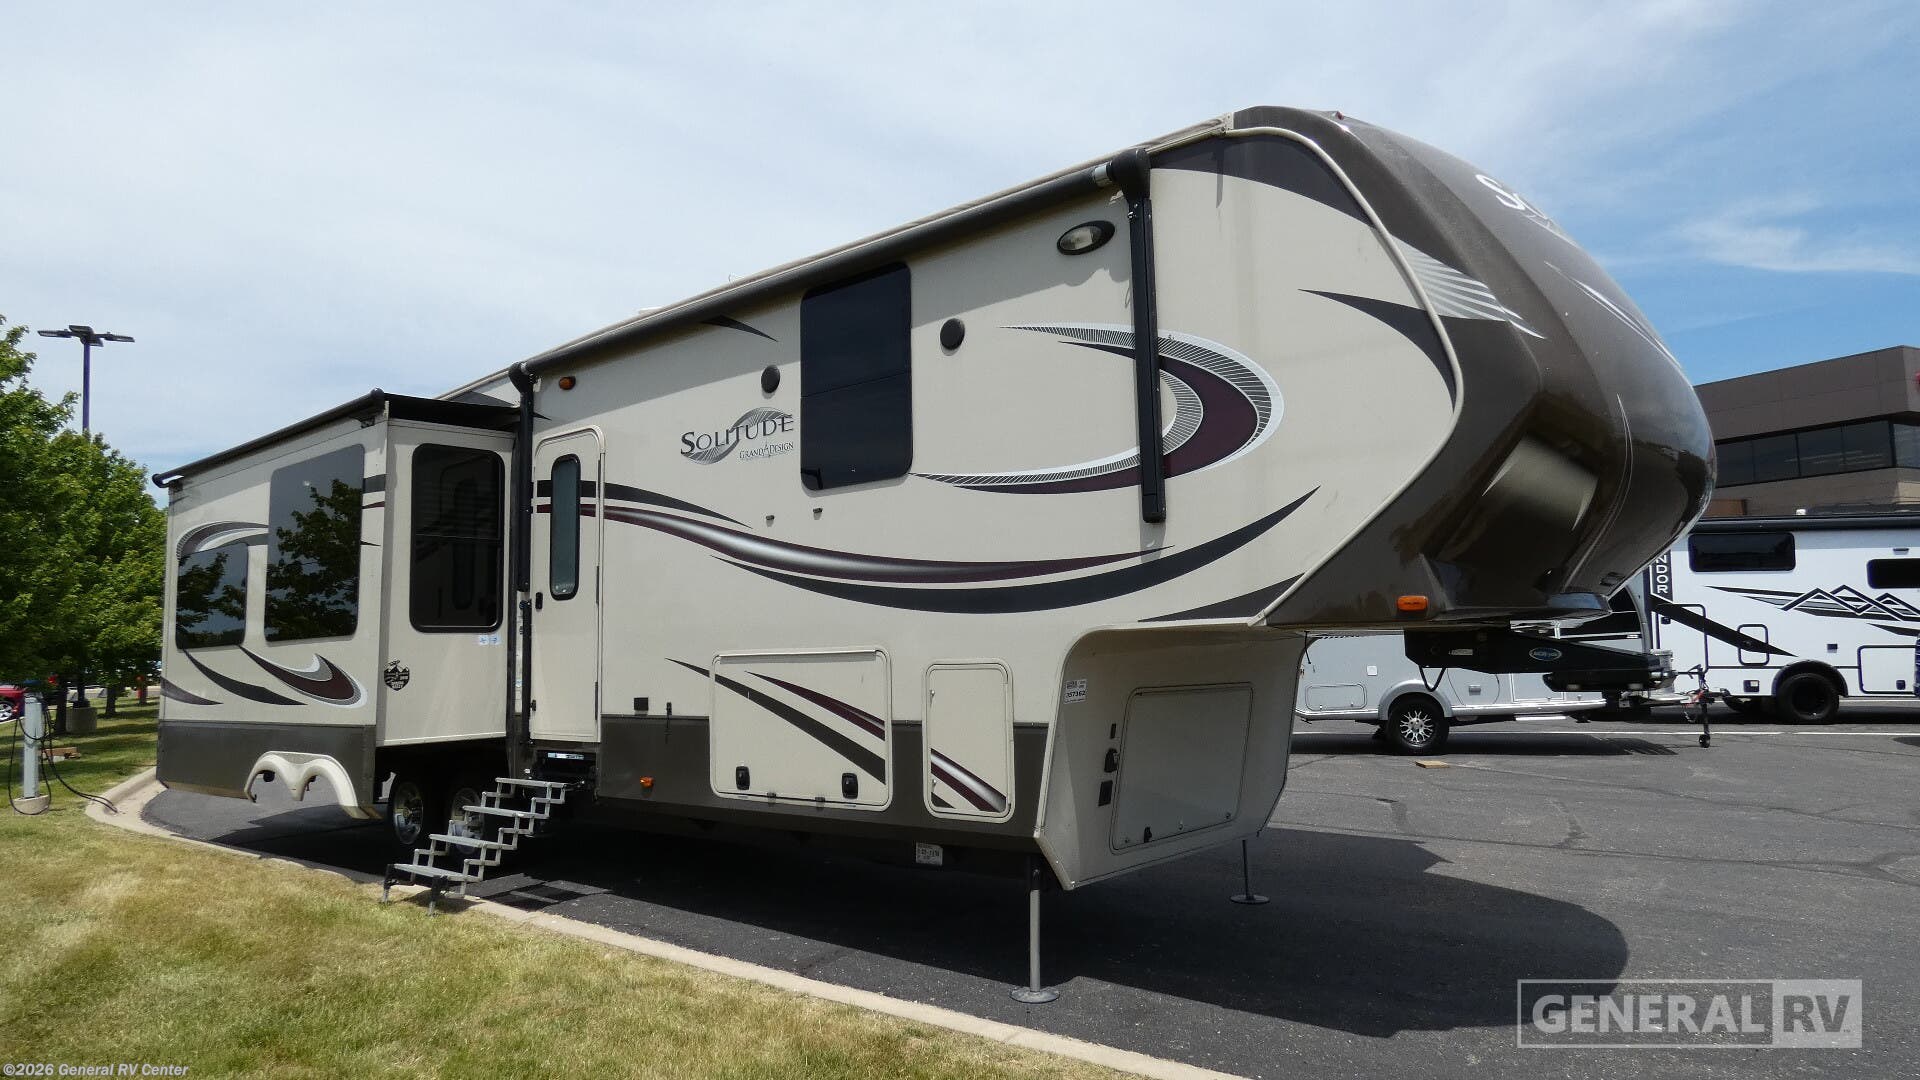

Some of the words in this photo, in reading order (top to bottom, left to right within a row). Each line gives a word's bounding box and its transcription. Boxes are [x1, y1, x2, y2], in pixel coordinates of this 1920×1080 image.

[680, 413, 795, 455] SOLITUDE
[739, 447, 764, 459] GRAND
[769, 441, 795, 454] DESIGN
